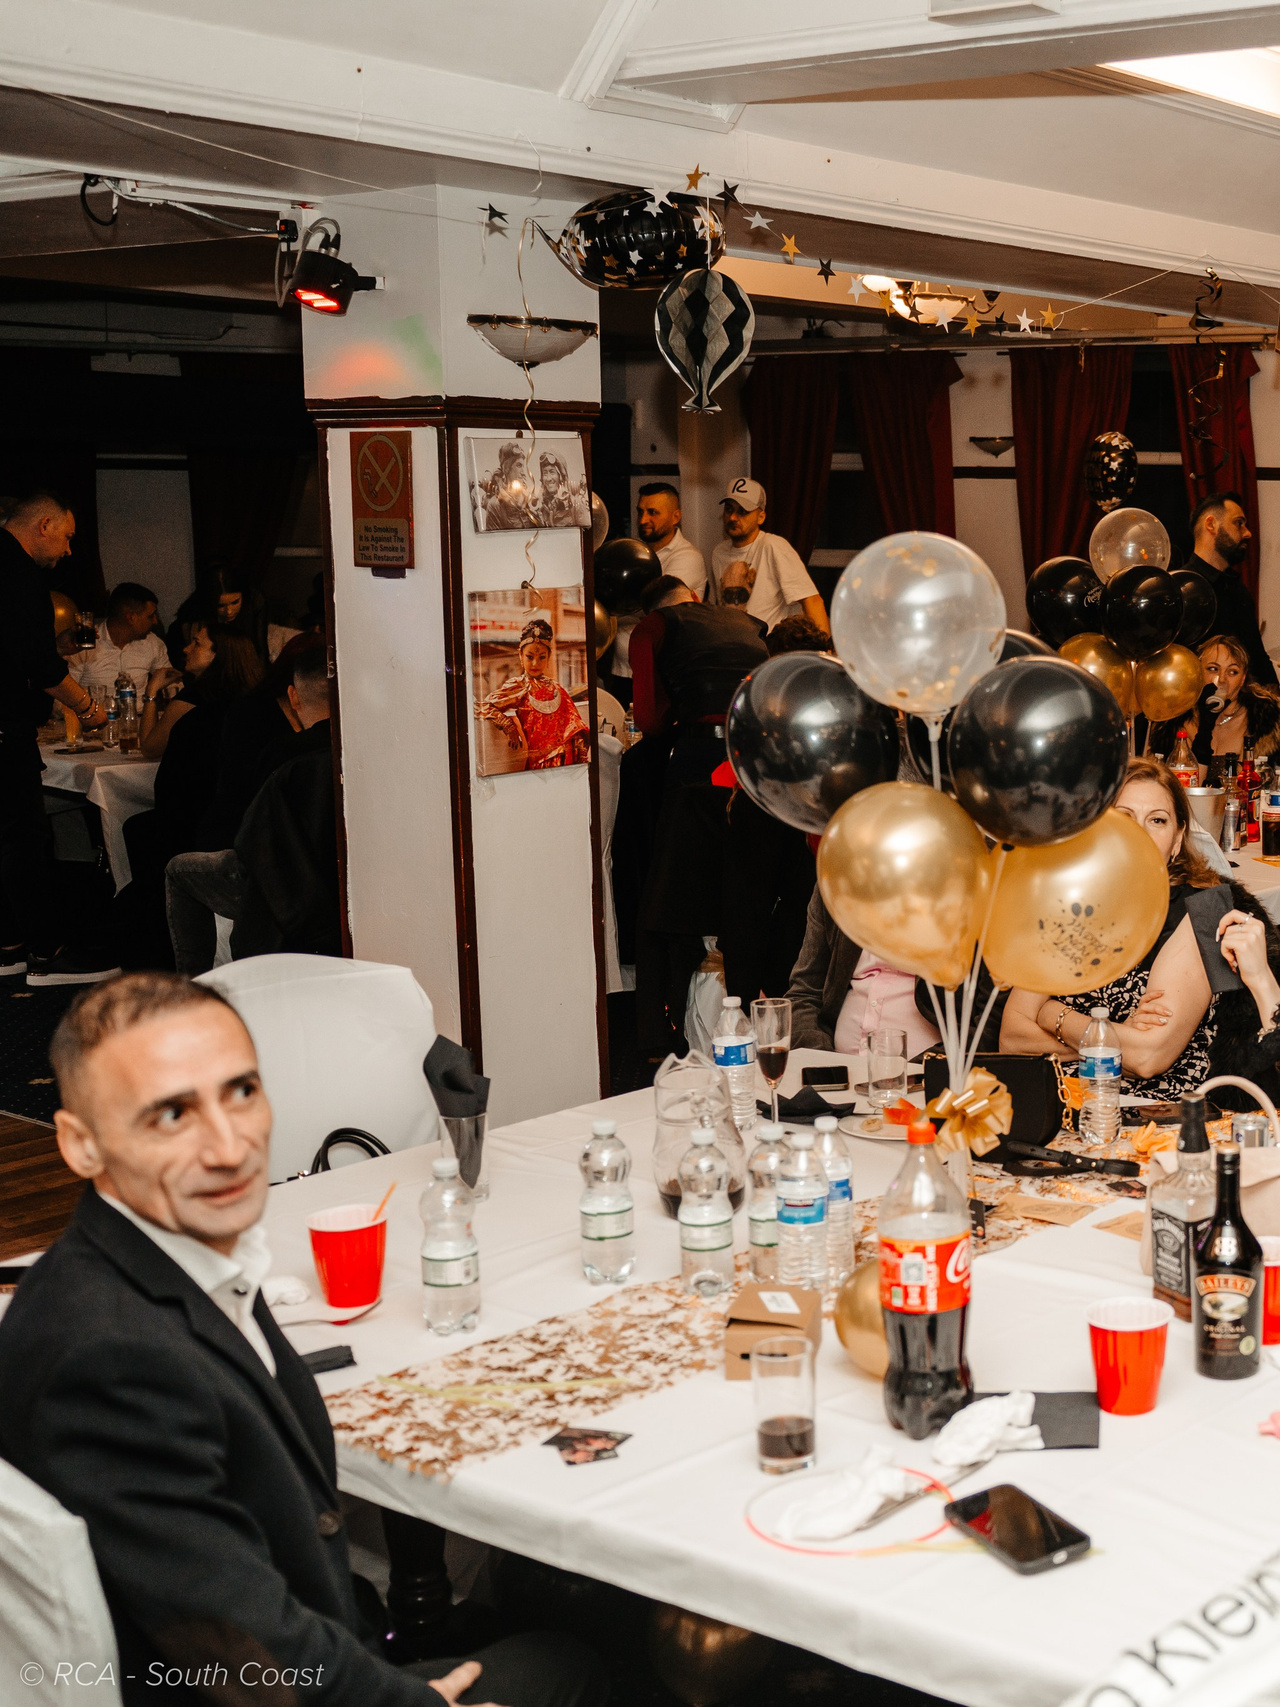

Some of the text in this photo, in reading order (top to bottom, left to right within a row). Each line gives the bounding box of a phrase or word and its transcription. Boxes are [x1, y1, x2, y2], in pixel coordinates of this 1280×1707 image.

[364, 525, 398, 535] No Smoking
[371, 535, 392, 544] Against
[393, 535, 404, 543] The
[361, 553, 405, 562] This Restaurant
[1200, 1277, 1250, 1293] BAILEYS
